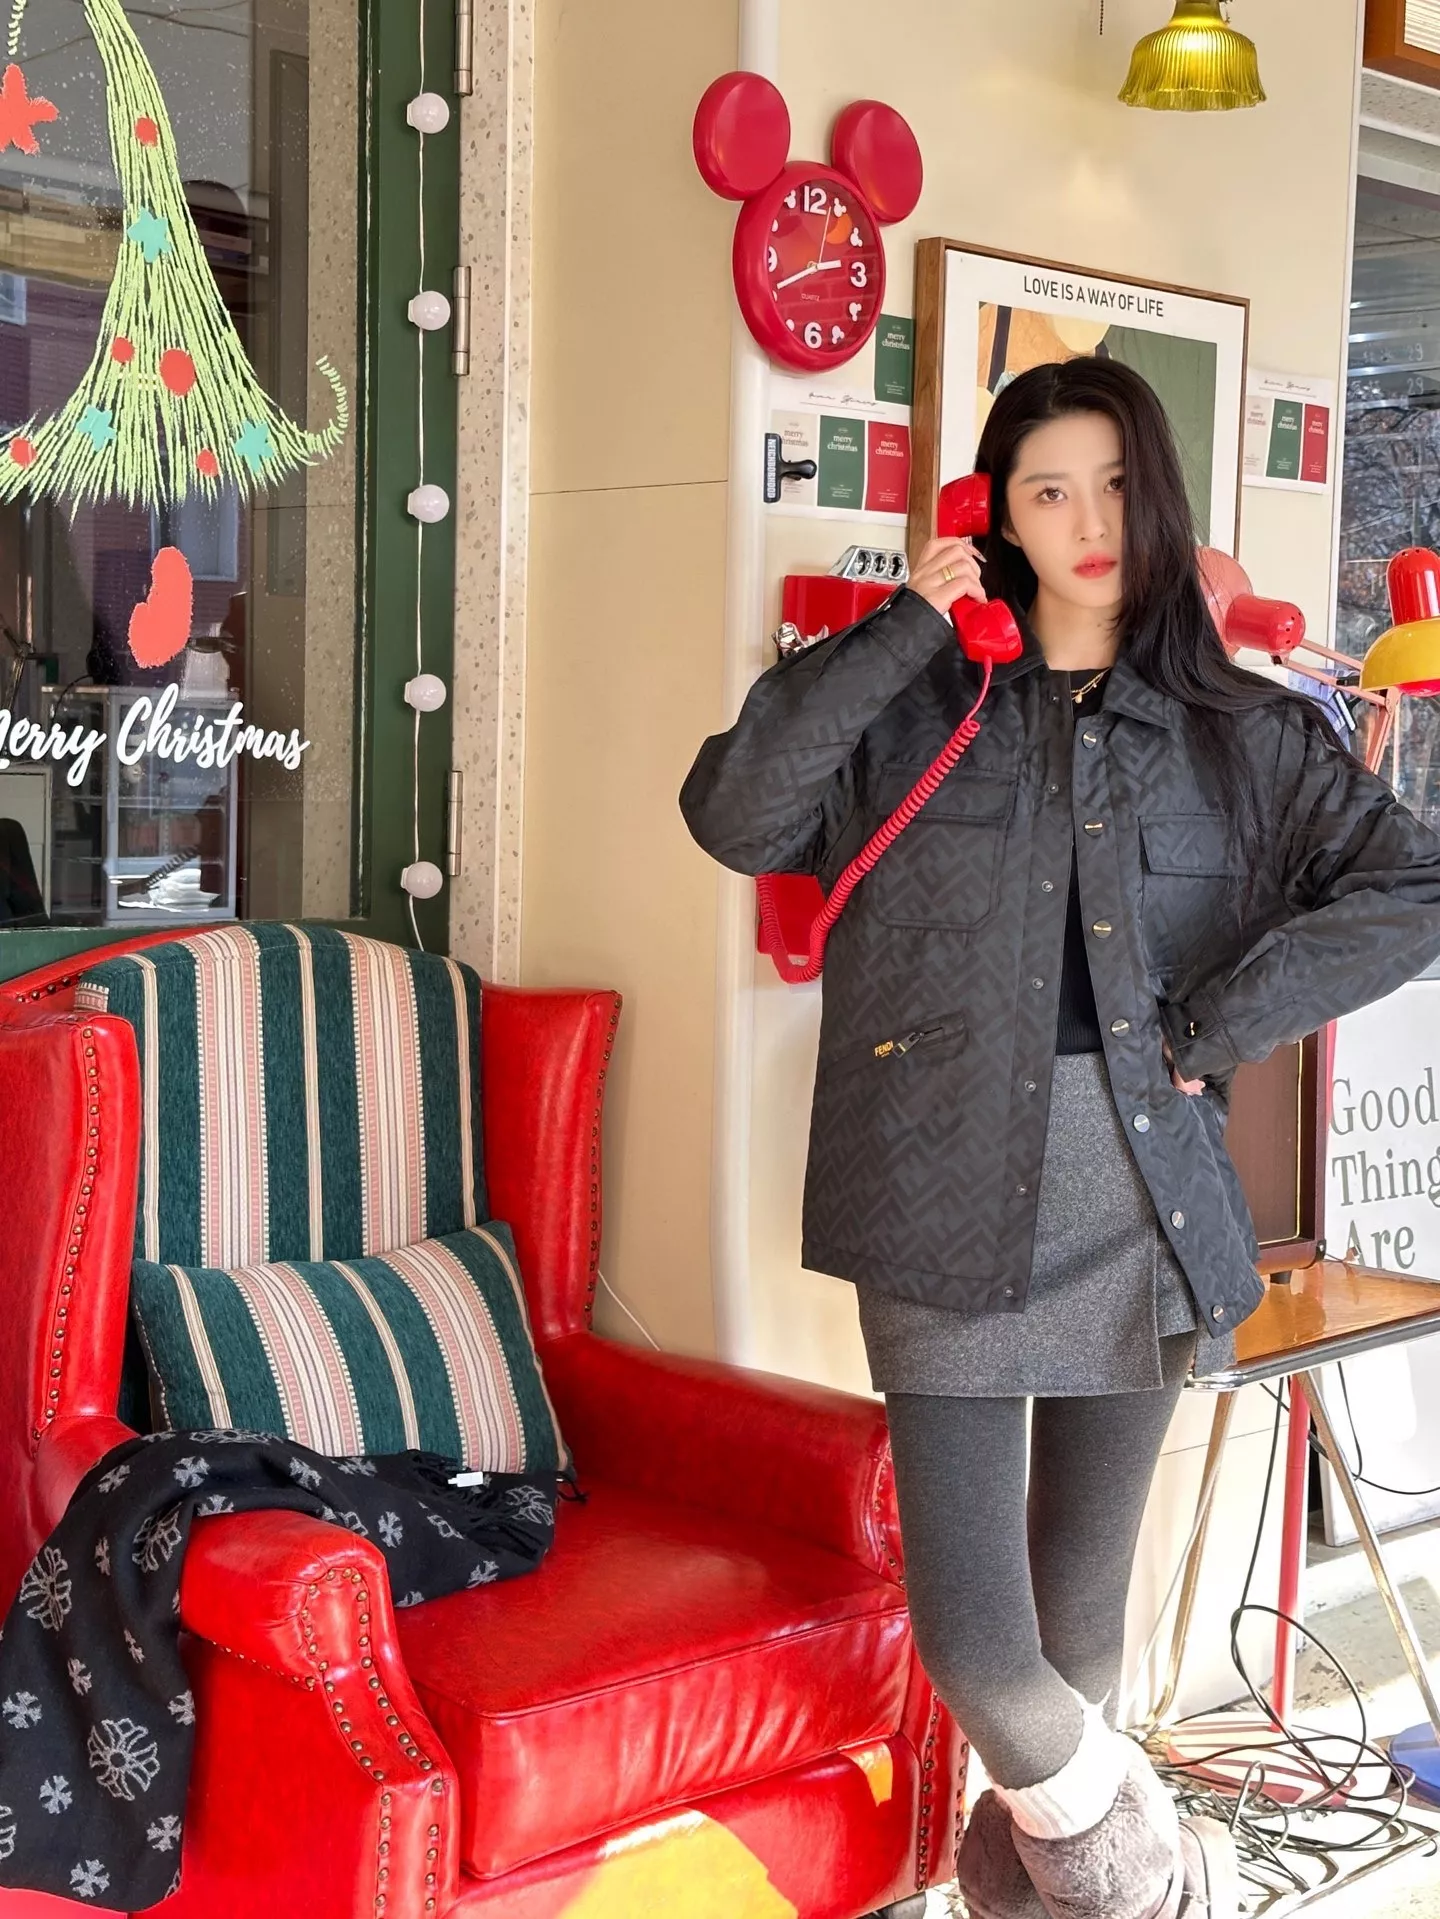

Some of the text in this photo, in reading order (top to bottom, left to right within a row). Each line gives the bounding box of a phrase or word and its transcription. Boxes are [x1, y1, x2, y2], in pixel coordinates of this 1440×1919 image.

[804, 185, 828, 216] 12
[850, 261, 867, 288] 3
[1023, 275, 1164, 317] LOVE IS A WAY OF LIFE
[804, 322, 822, 349] 6
[781, 436, 809, 448] hristmas
[827, 441, 858, 453] christmas
[833, 434, 853, 445] merry
[880, 440, 898, 450] merry
[875, 446, 904, 458] christmas
[116, 682, 311, 771] Christmas
[874, 1040, 894, 1057] FENDI
[1331, 1066, 1439, 1136] Good
